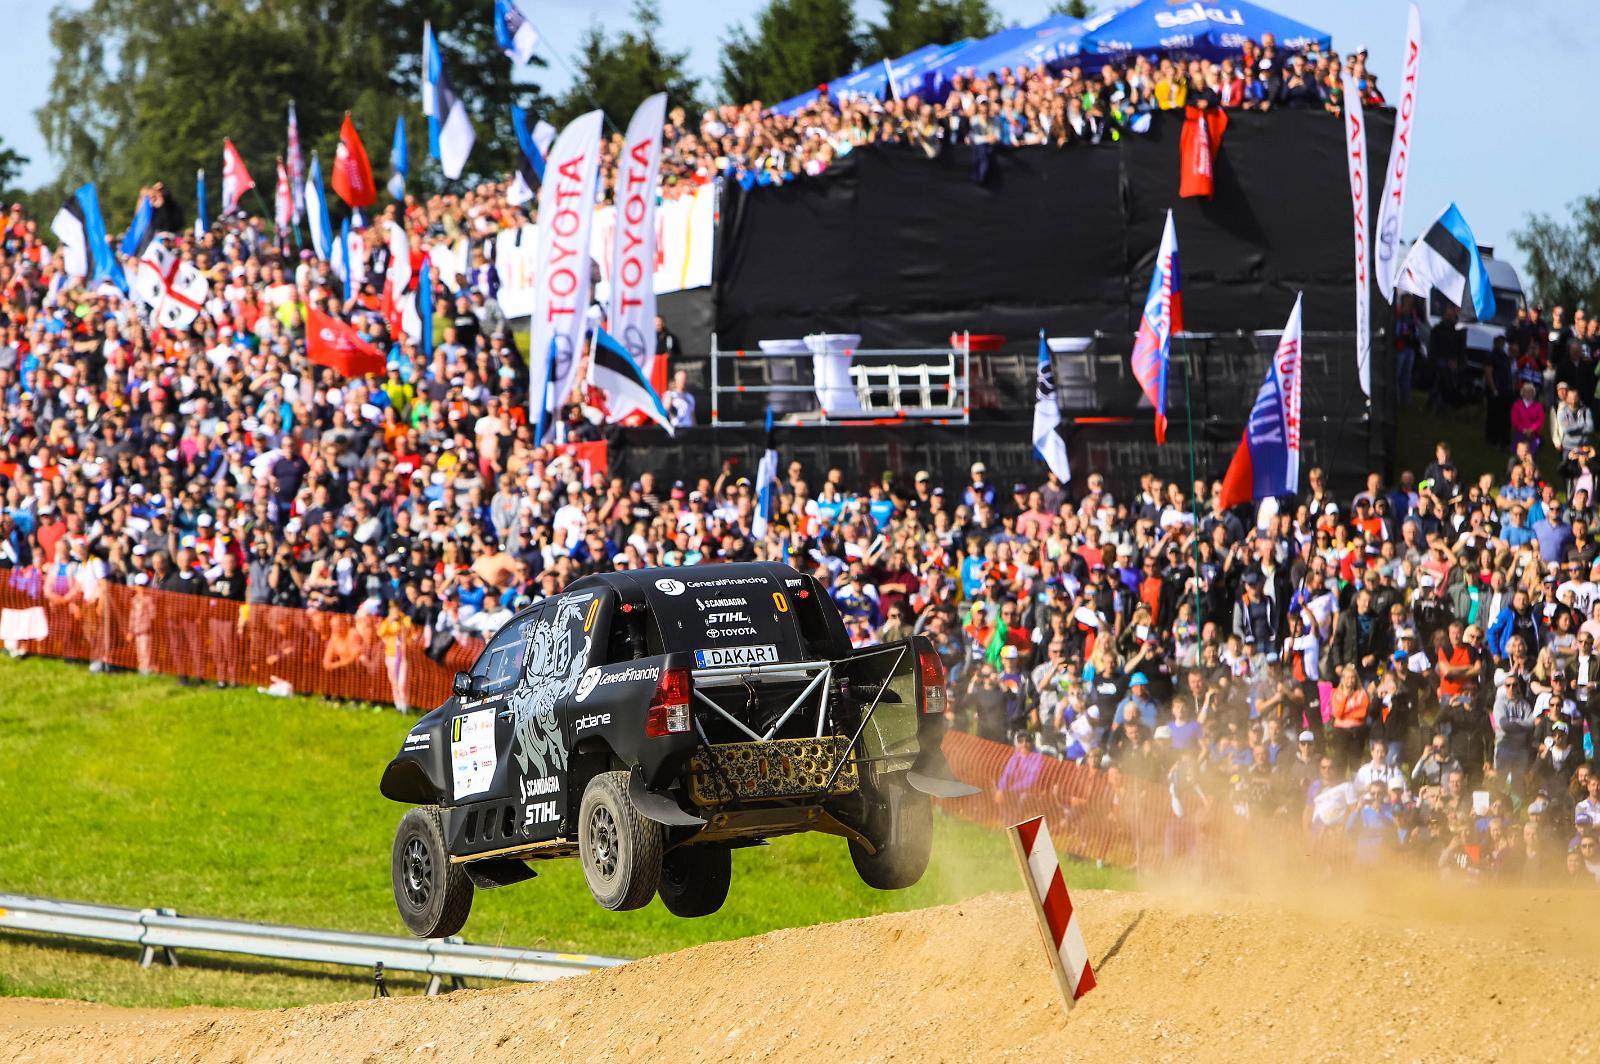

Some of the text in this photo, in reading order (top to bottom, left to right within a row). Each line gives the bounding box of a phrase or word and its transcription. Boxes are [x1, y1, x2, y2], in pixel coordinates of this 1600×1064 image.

[1154, 2, 1244, 28] saku
[619, 137, 653, 316] TOYOTA
[548, 154, 585, 322] TOYOTA
[687, 577, 768, 589] GeneralFinancing
[704, 598, 747, 608] SCANDAGRA
[772, 592, 788, 613] 0
[708, 612, 749, 624] STIHL
[720, 627, 757, 637] TOYOTA
[599, 665, 659, 685] GeneralFinancing
[526, 776, 560, 797] SCANDAGRA
[525, 800, 560, 825] STIHL
